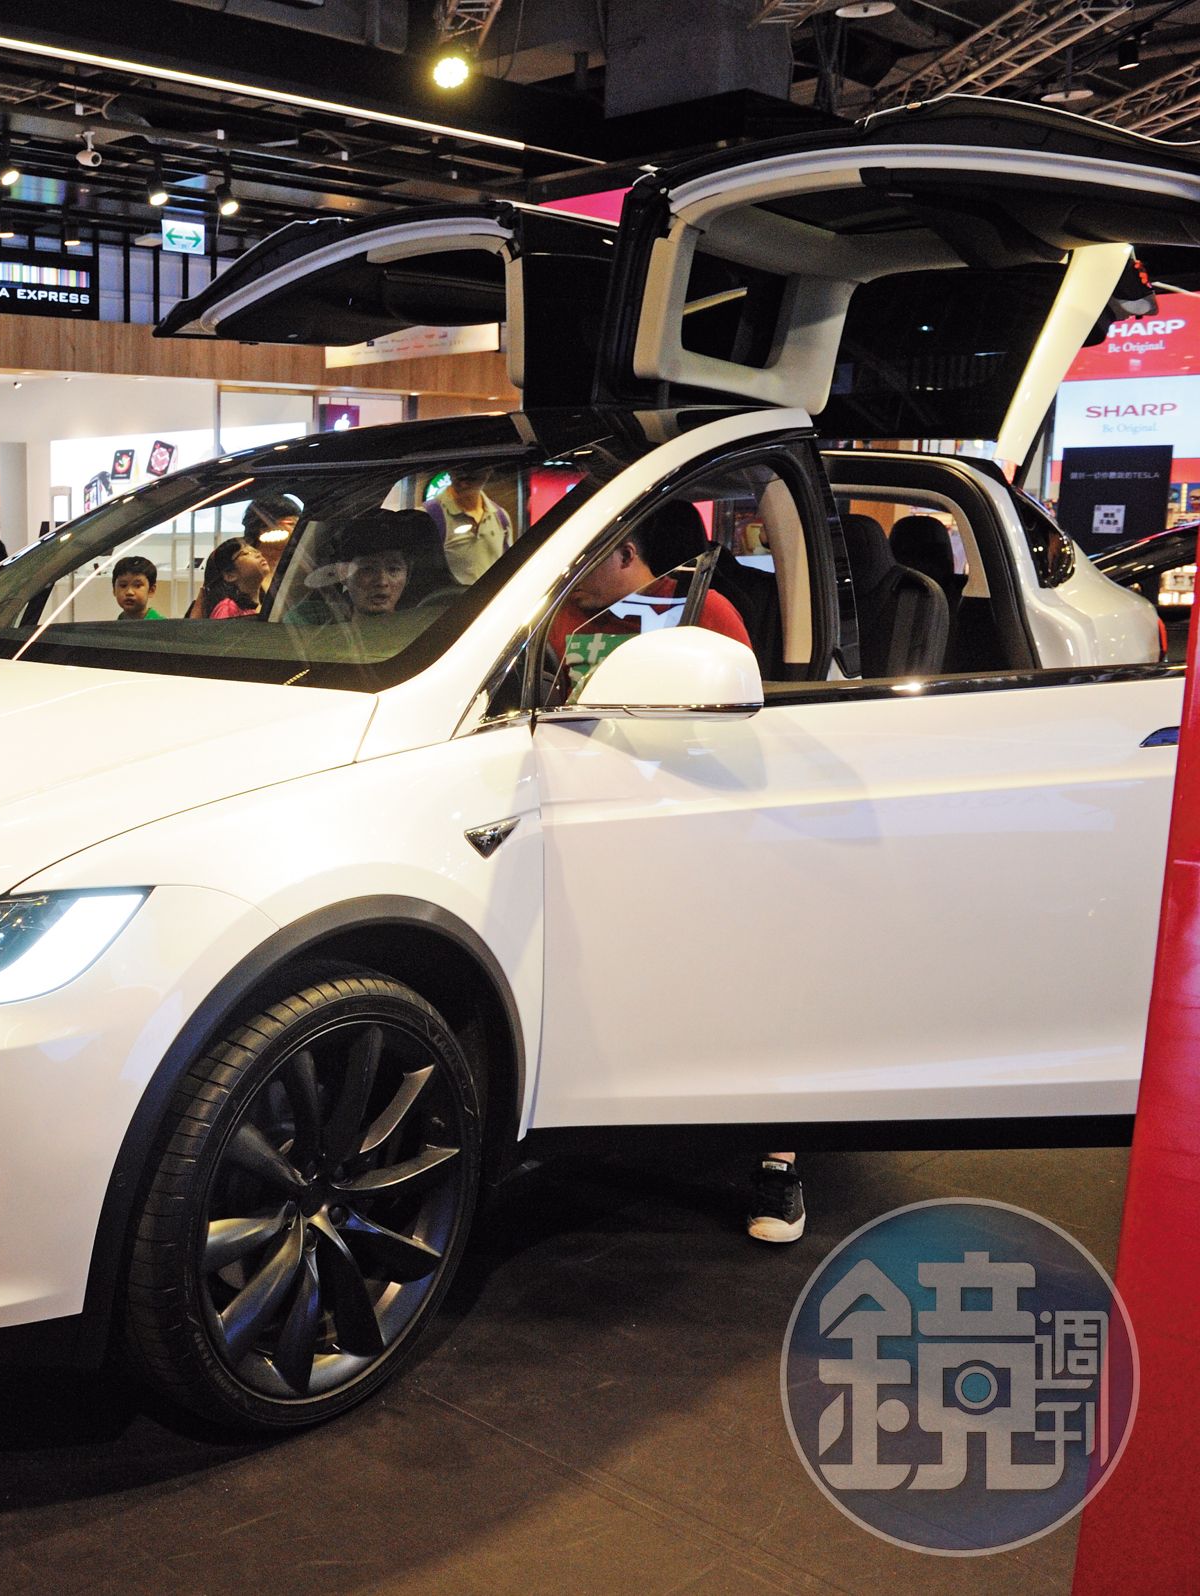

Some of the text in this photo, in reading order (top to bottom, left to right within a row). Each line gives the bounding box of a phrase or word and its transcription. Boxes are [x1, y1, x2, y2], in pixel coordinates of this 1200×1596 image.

[16, 288, 91, 305] EXPRESS
[1106, 319, 1186, 338] HARP
[1108, 343, 1121, 353] Be
[1085, 403, 1178, 418] SHARP
